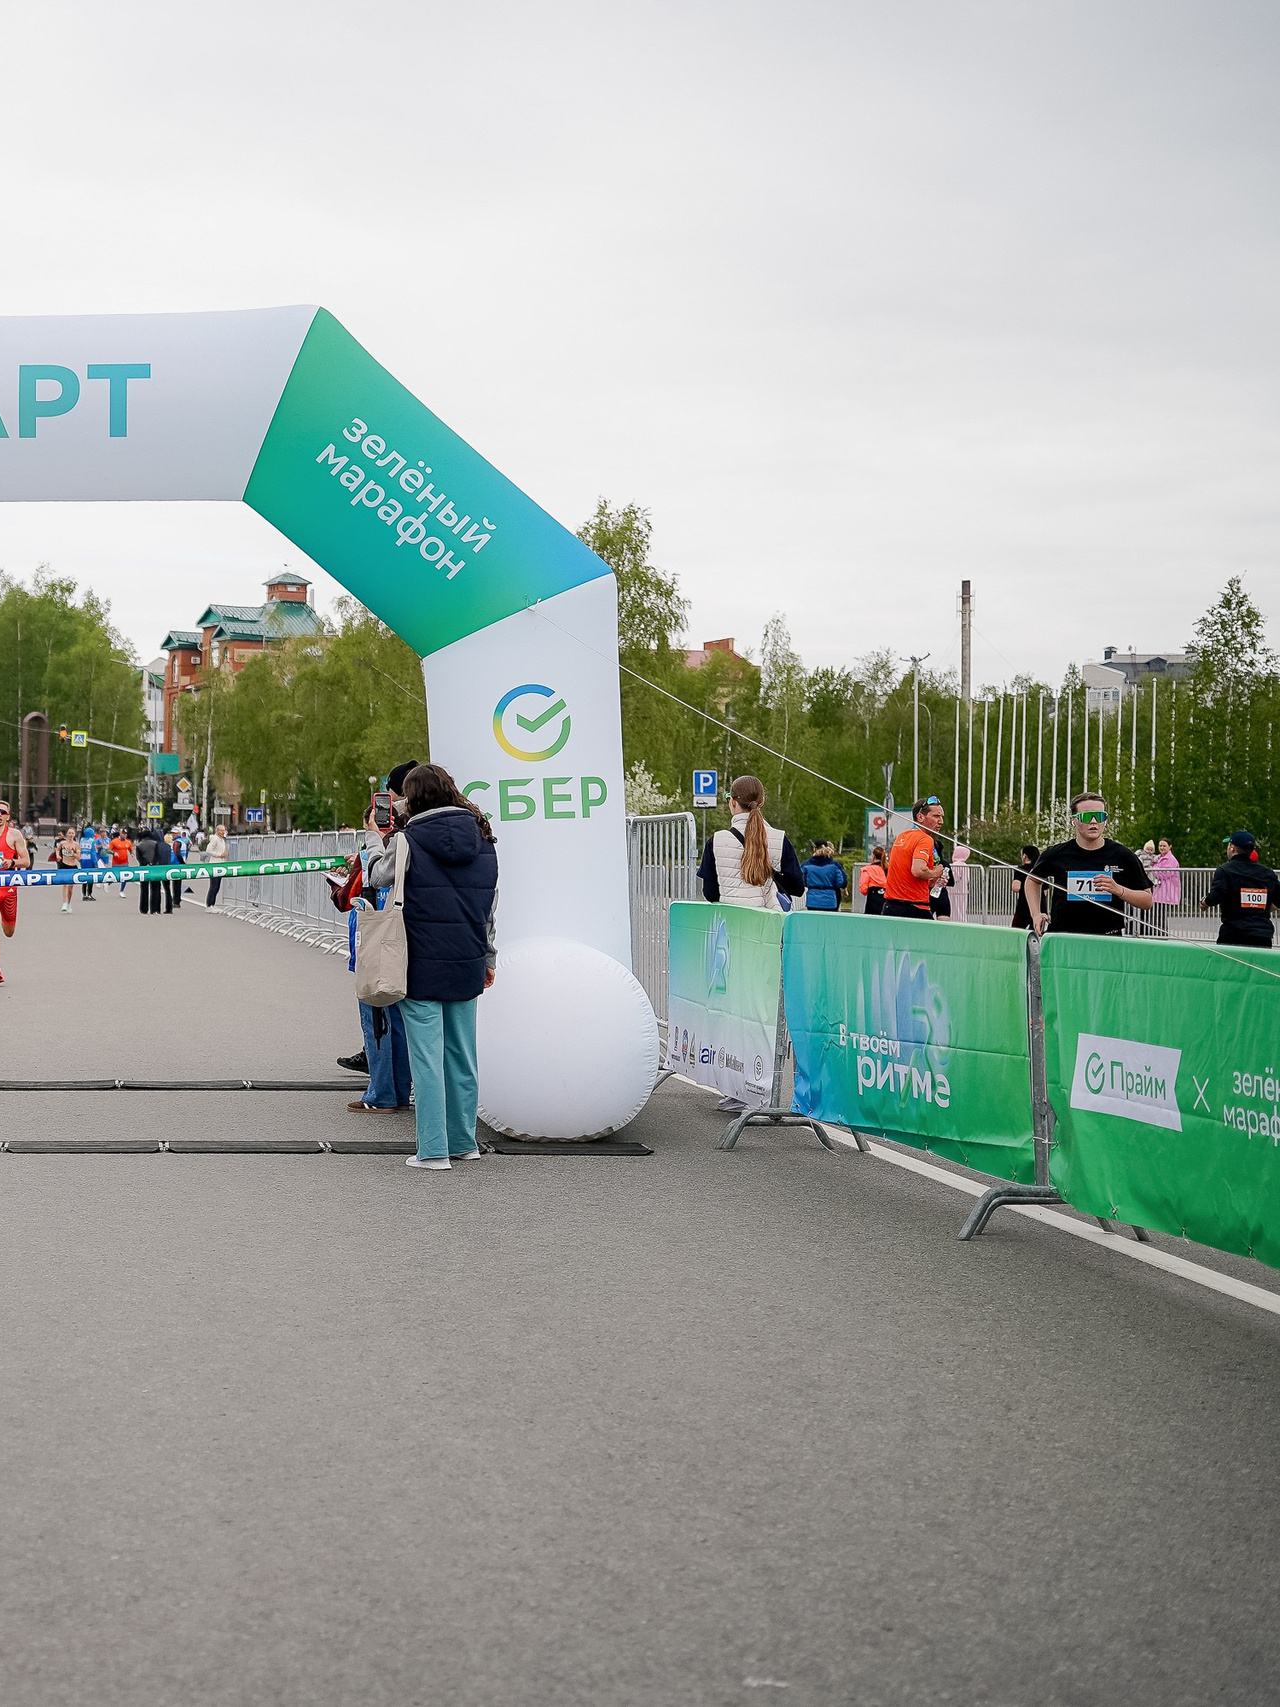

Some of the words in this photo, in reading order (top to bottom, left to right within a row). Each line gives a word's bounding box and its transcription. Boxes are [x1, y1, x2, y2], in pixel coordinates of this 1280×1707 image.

[342, 417, 497, 554] зелёный
[315, 443, 466, 581] марафон
[72, 870, 150, 884] СТАРТ
[166, 865, 242, 880] СТАРТ
[1076, 880, 1105, 892] 71
[1247, 894, 1262, 902] 100
[849, 1031, 900, 1058] твоём
[857, 1055, 951, 1108] ритме
[1110, 1060, 1166, 1100] Прайм
